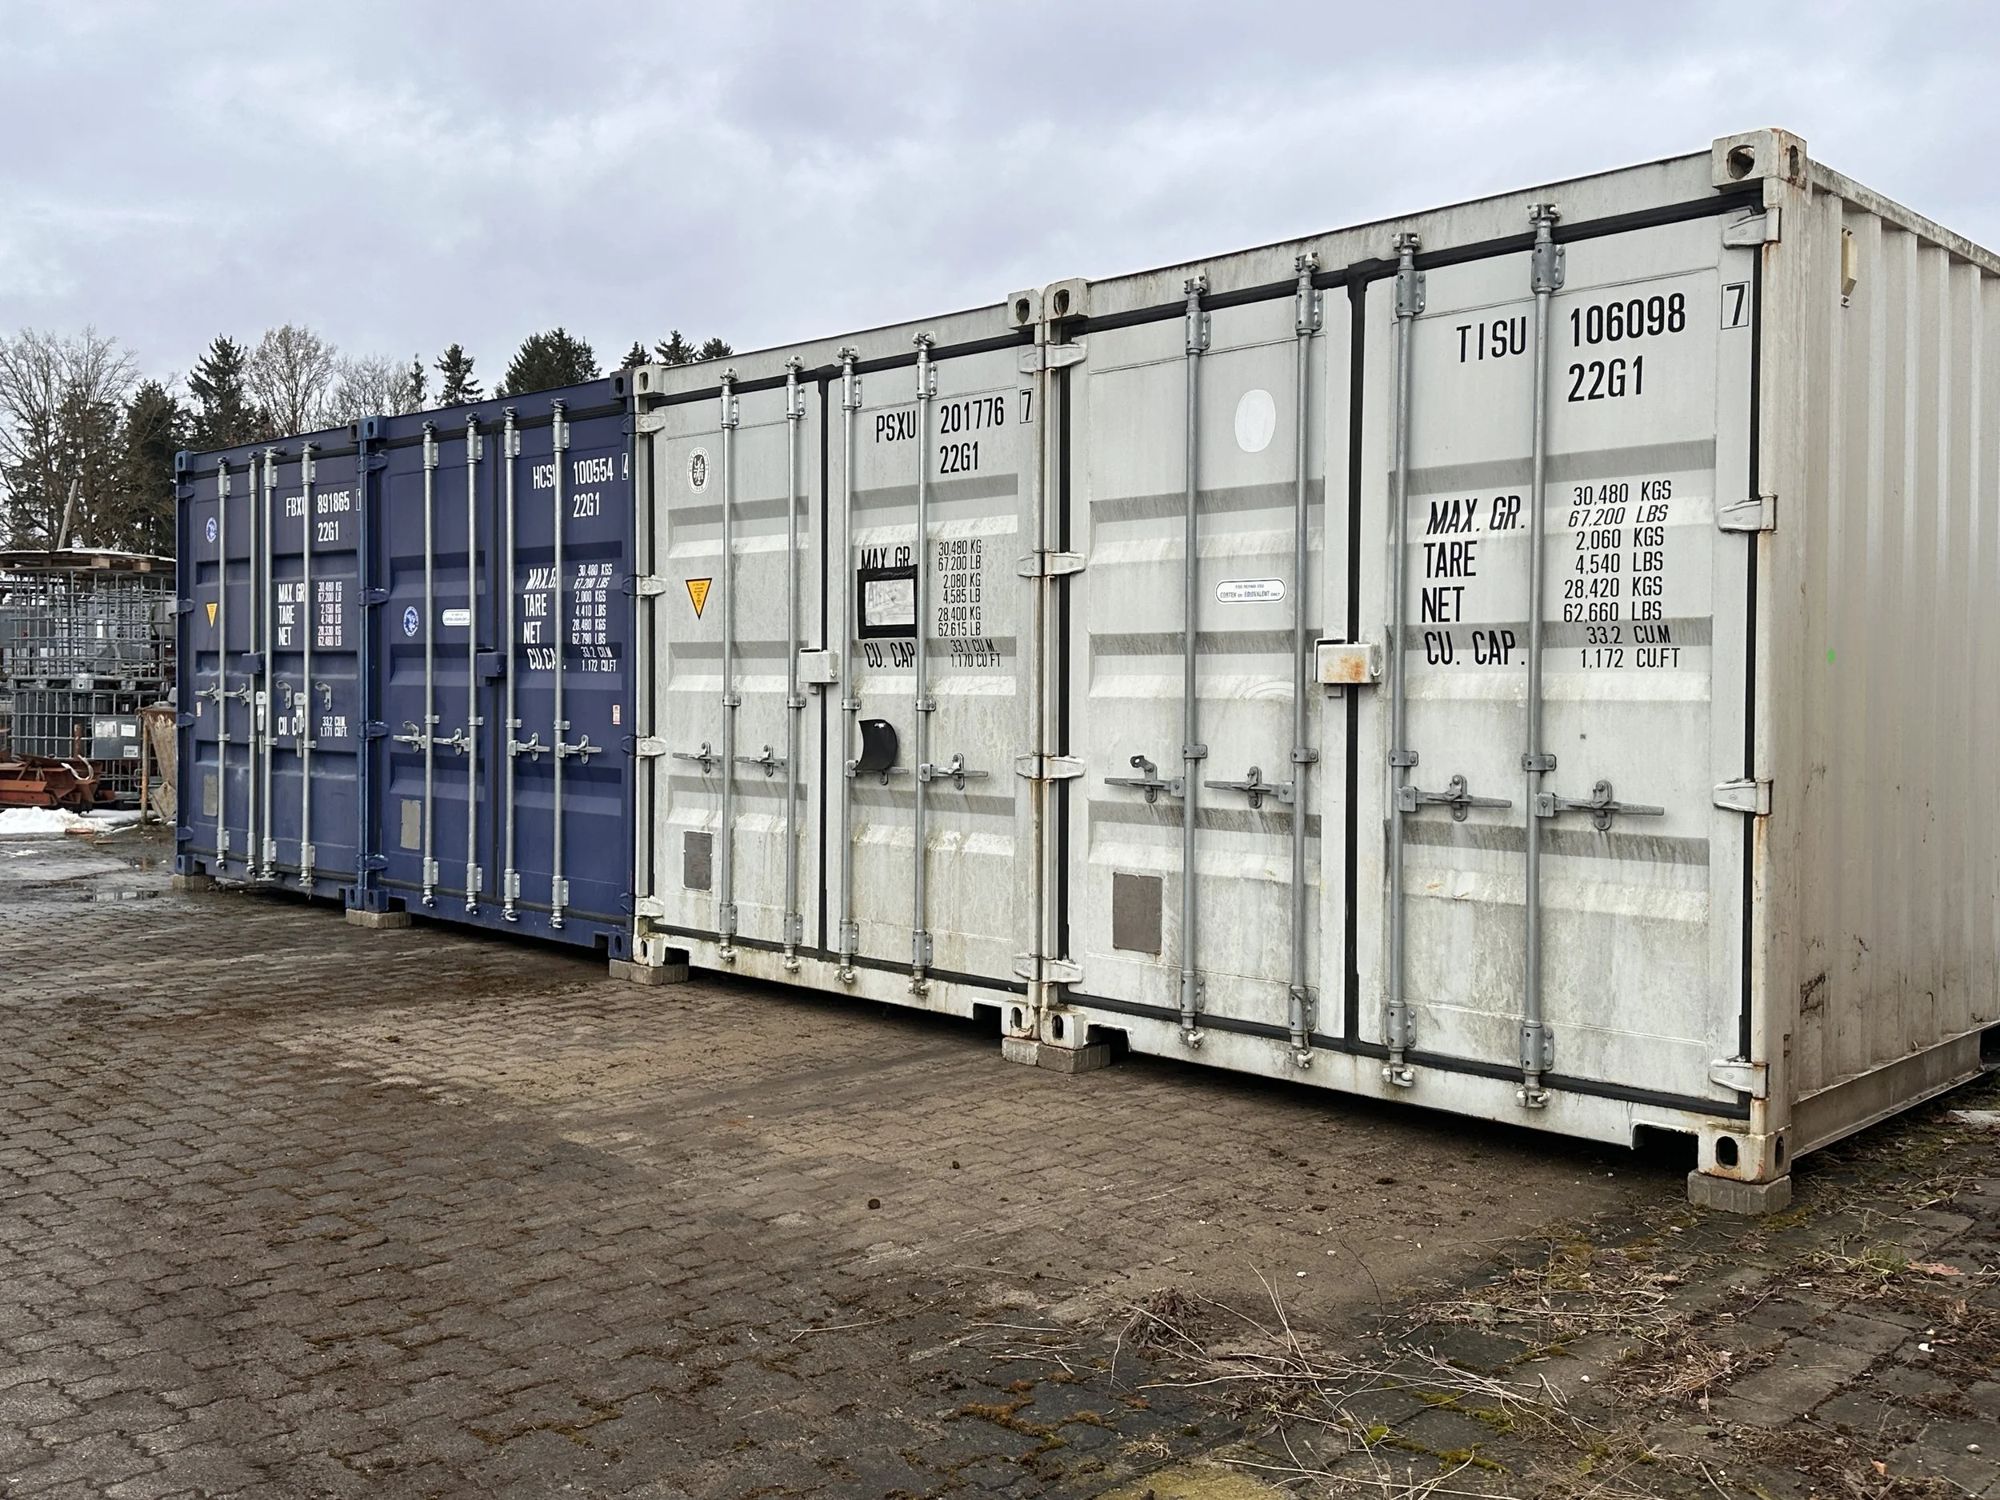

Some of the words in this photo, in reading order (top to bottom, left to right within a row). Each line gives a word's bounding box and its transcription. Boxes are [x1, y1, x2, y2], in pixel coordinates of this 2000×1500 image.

[1456, 316, 1527, 363] TISU
[1570, 292, 1686, 347] 106098
[1726, 284, 1746, 326] 7
[1567, 355, 1644, 403] 22G1
[876, 410, 916, 443] PSXU
[940, 396, 1005, 434] 201776
[1022, 391, 1032, 421] 7
[940, 441, 979, 474] 22G1
[573, 457, 614, 485] 100554
[317, 491, 350, 514] 891865
[573, 492, 600, 518] 22G1
[1573, 483, 1629, 507] 30,480
[1641, 480, 1672, 501] KGS
[1426, 498, 1481, 535] MAX.
[1489, 495, 1526, 531] GR.
[1568, 507, 1626, 528] 67,200
[1635, 504, 1669, 524] LBS
[317, 520, 339, 542] 22G1
[1576, 528, 1621, 551] 2,060
[1633, 526, 1664, 548] KGS
[970, 539, 982, 554] KG
[970, 555, 982, 570] LB
[1424, 540, 1477, 578] TARE
[1575, 553, 1620, 575] 4,540
[1632, 551, 1663, 572] LBS
[970, 573, 981, 588] KG
[1564, 578, 1620, 599] 28,420
[1632, 576, 1662, 597] KGS
[523, 593, 547, 617] TARE
[970, 588, 981, 603] LB
[1421, 586, 1465, 623] NET
[278, 605, 295, 624] TARE
[594, 604, 607, 617] LBS
[970, 606, 981, 621] KG
[1563, 602, 1619, 623] 62,660
[1631, 601, 1662, 621] LBS
[278, 626, 292, 646] NET
[523, 621, 542, 644] NET
[594, 632, 606, 645] LBS
[970, 622, 981, 636] LB
[1588, 626, 1623, 644] 33.2
[1634, 625, 1671, 644] CU.M
[1424, 631, 1461, 665] CU.
[1581, 649, 1624, 668] 1,172
[1636, 648, 1680, 668] CU.FT
